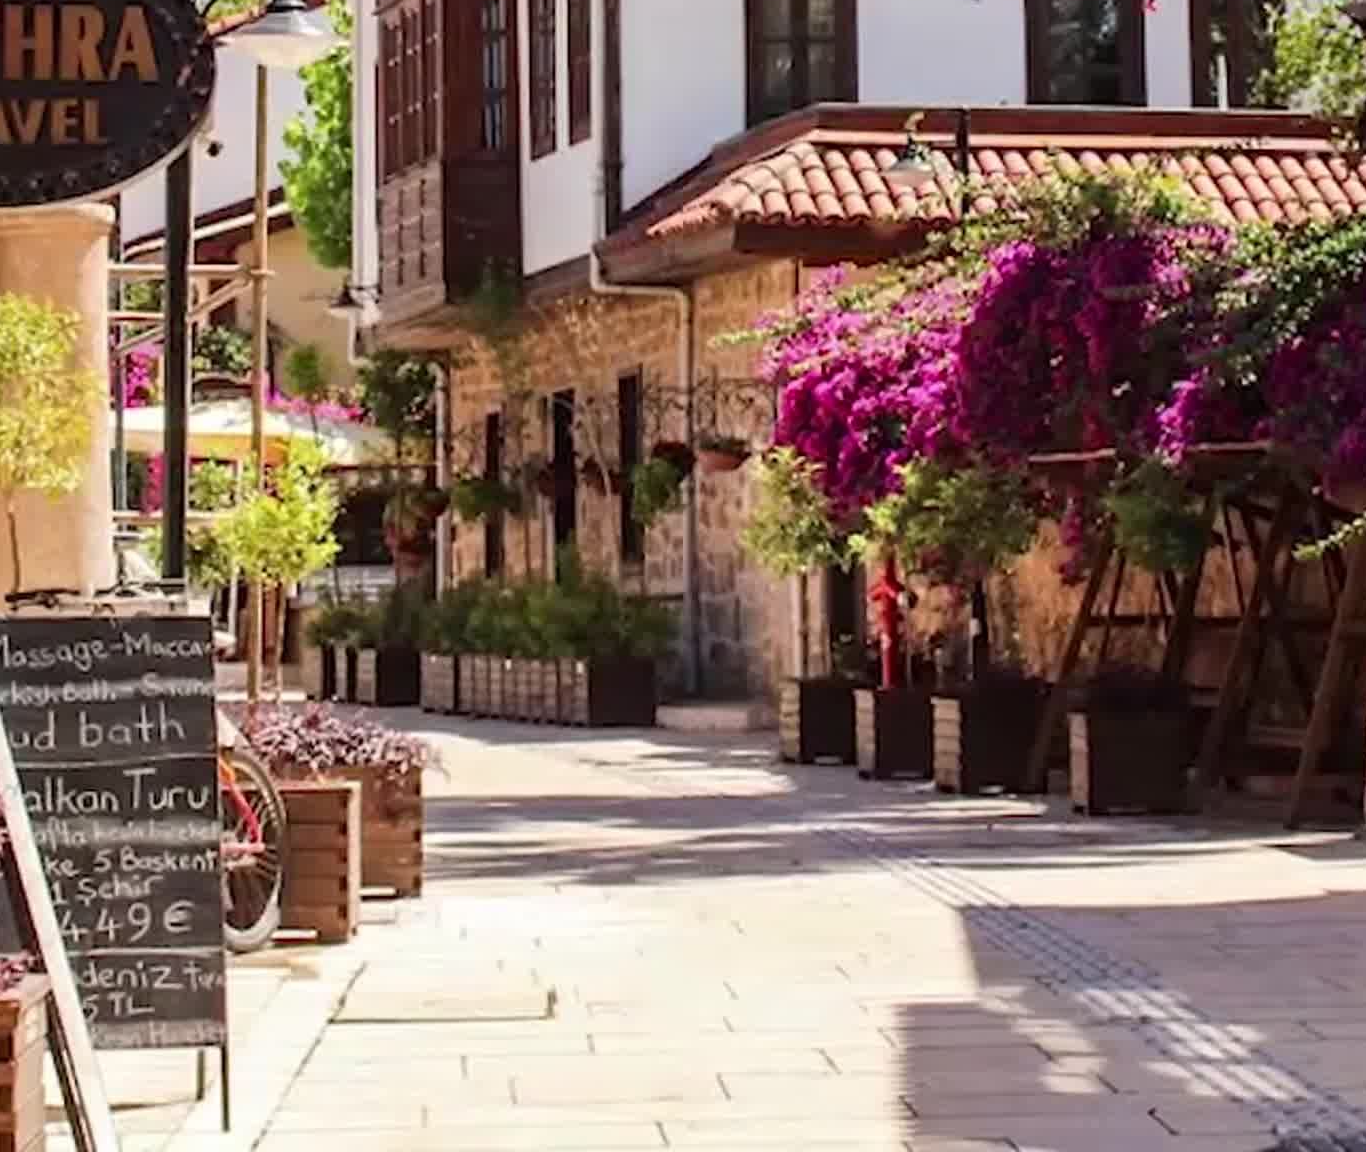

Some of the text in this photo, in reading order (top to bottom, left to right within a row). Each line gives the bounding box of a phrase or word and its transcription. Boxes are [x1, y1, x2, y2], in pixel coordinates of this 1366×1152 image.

[8, 700, 186, 750] ud bath
[25, 767, 210, 814] alkan Turu
[81, 961, 184, 991] deniz
